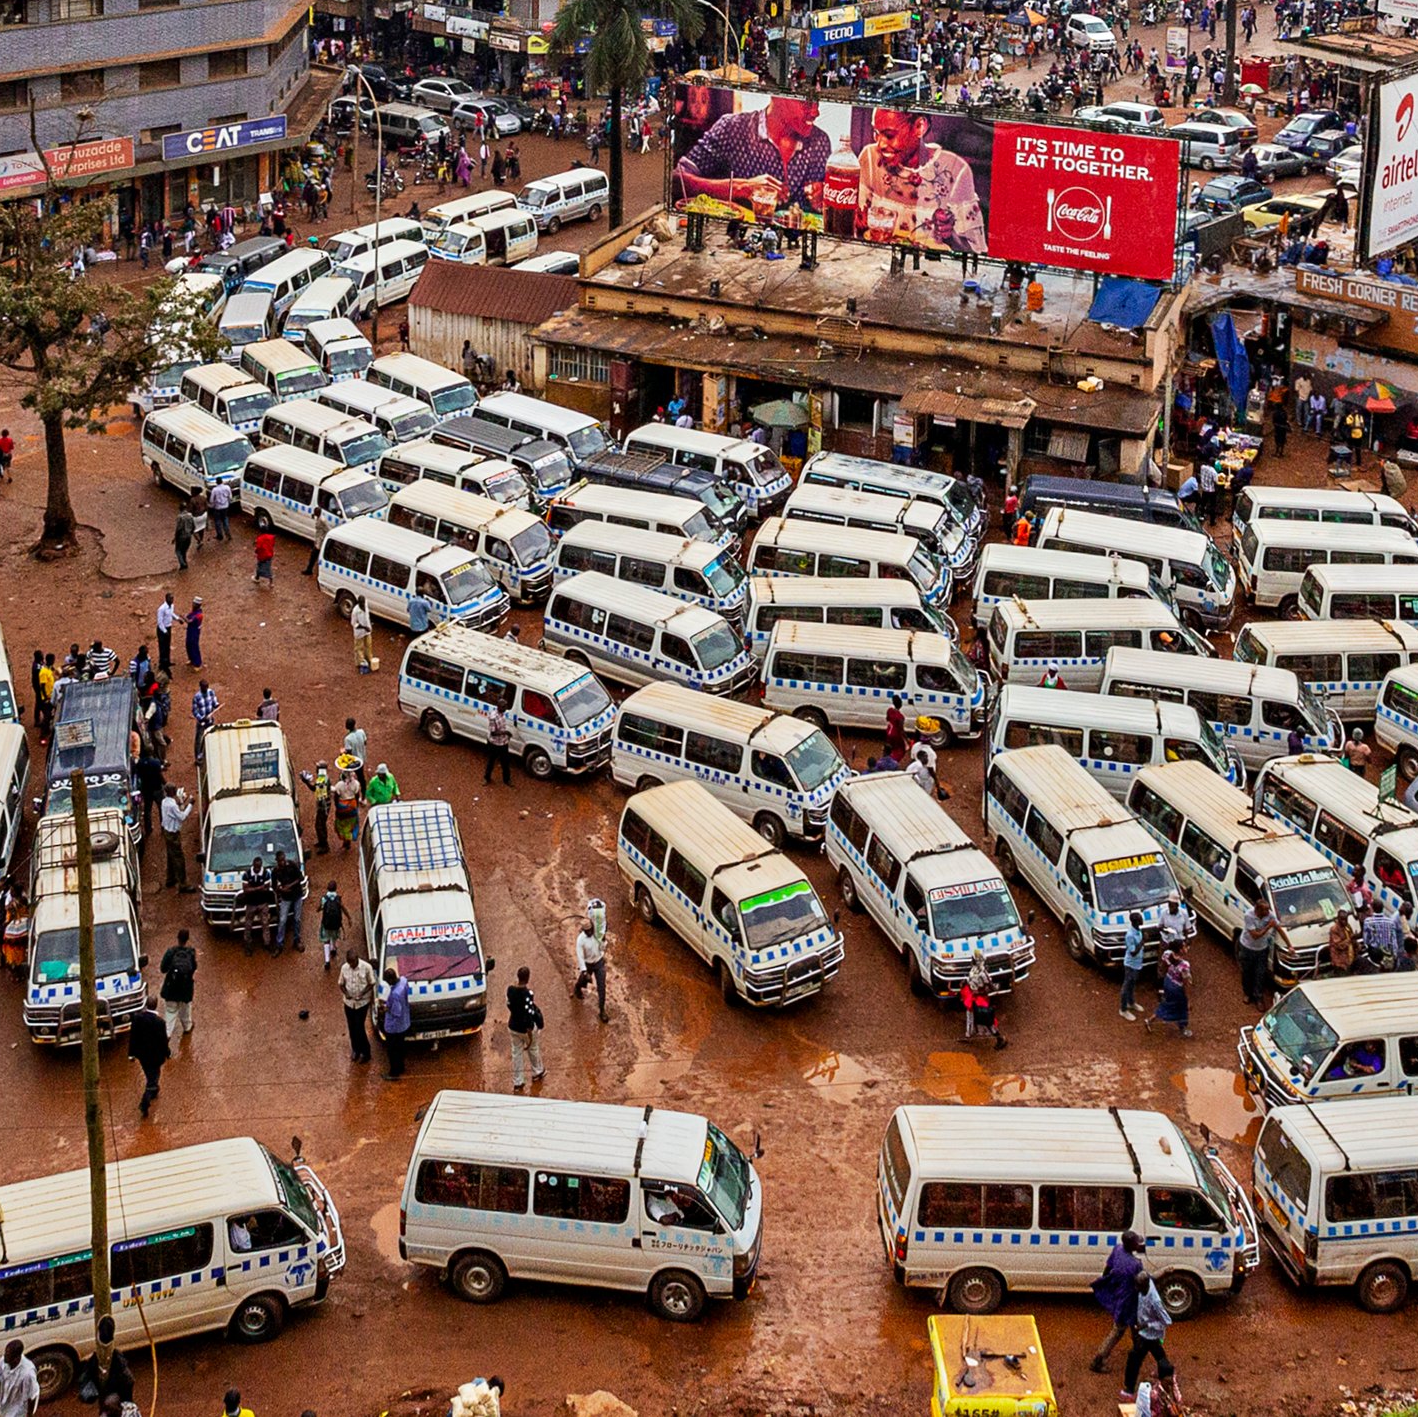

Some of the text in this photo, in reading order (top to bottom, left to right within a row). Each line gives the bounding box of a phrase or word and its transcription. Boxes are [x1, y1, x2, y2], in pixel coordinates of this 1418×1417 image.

[823, 26, 854, 42] TECNO
[186, 125, 242, 153] CEAT
[1016, 136, 1125, 162] IT'S TIME TO
[11, 159, 40, 170] TOTAL
[51, 152, 126, 177] Enterprises Ltd
[1015, 151, 1155, 182] EAT TOGETHER.
[1382, 149, 1418, 189] airtel
[2, 173, 37, 186] Lubricants
[1056, 202, 1102, 223] Coca-Cola
[1043, 242, 1111, 260] TASTE THE FEELING
[1302, 272, 1343, 295] FRESH
[1347, 282, 1397, 307] CORNER
[1094, 854, 1157, 873] BISMILLAH
[931, 879, 1004, 901] BISMILLAH
